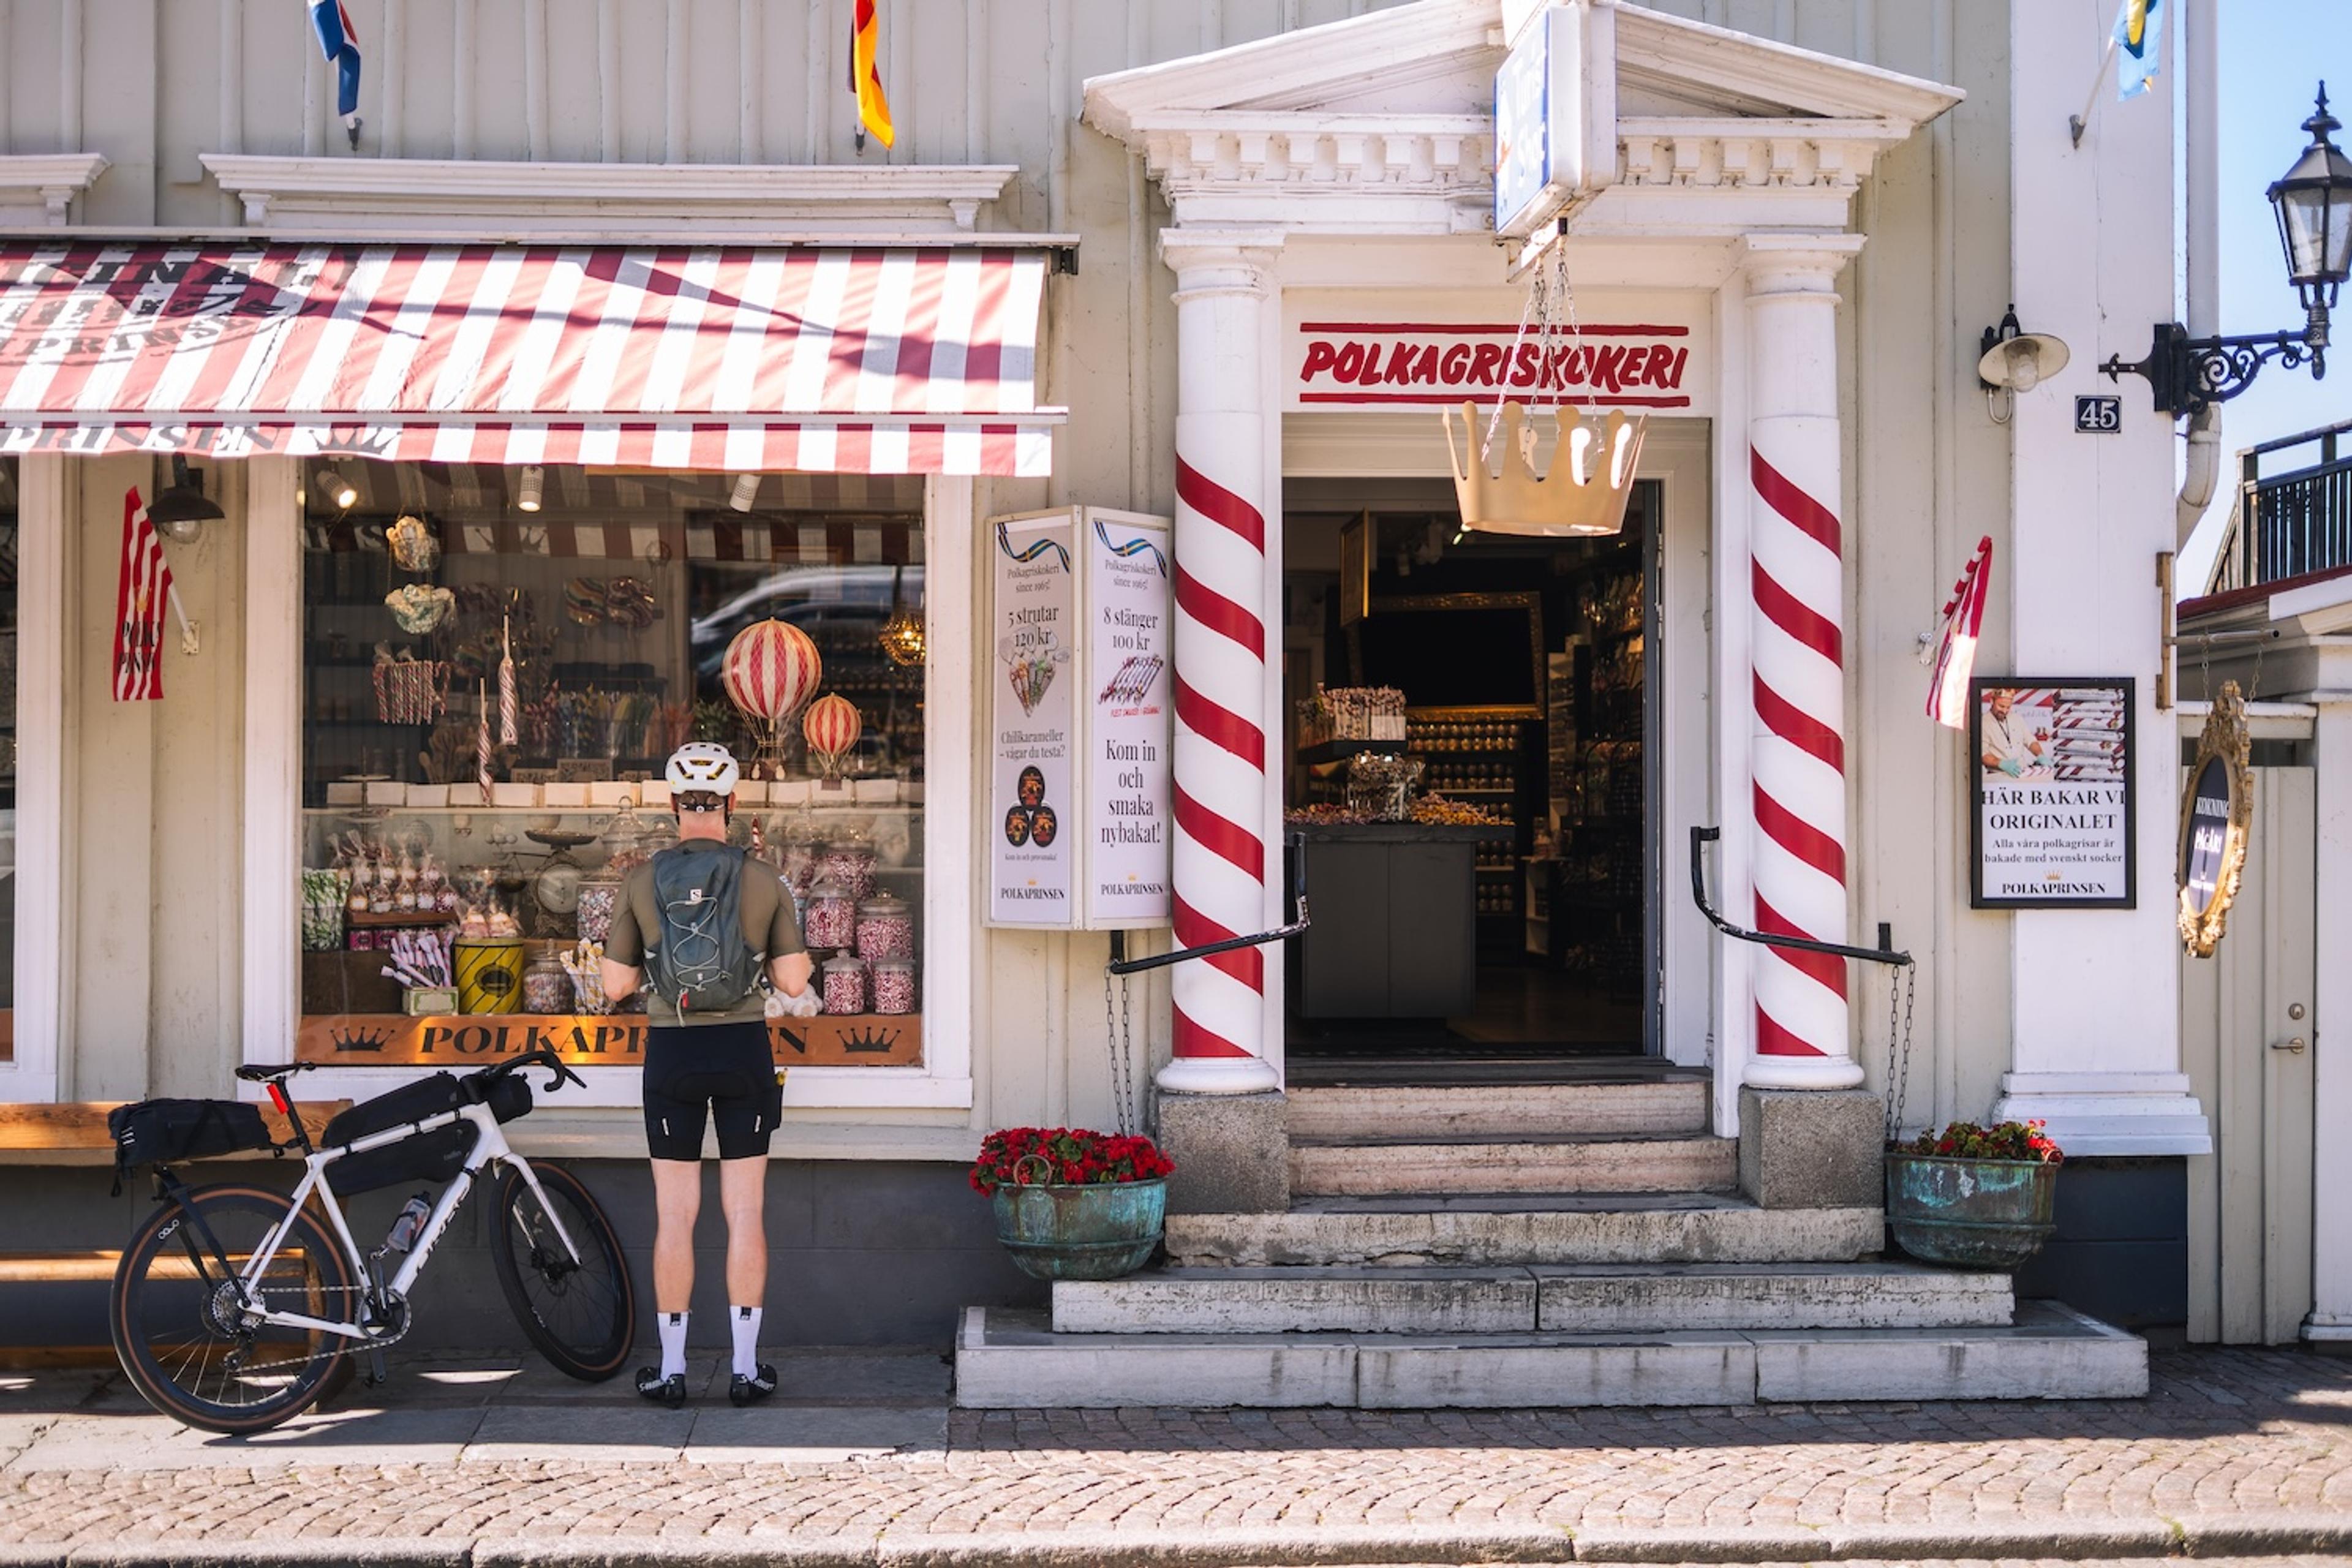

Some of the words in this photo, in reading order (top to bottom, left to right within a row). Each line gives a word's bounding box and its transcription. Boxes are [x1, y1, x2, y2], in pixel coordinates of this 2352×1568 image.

[1300, 341, 1689, 394] POLKAGRISKOKERI
[2080, 401, 2117, 428] 45
[1105, 560, 1156, 577] Polkagriskokeri
[1016, 582, 1033, 593] since
[1113, 575, 1131, 587] since
[1009, 612, 1014, 628] 5
[1016, 605, 1059, 624] strutar
[1104, 606, 1111, 625] 8
[1114, 608, 1158, 631] stänger
[1015, 632, 1035, 647] 120
[1038, 627, 1052, 645] kr
[1112, 635, 1134, 650] 100
[1136, 631, 1150, 650] kr
[1030, 745, 1039, 758] du
[1041, 744, 1065, 758] testa?
[1106, 739, 1139, 761] Kom
[1142, 739, 1156, 761] in
[1118, 766, 1144, 788] och
[1108, 793, 1154, 816] smaka
[1982, 786, 2025, 805] HÄR
[2030, 790, 2100, 805] BAKAR
[2105, 790, 2125, 804] VI
[1990, 814, 2117, 829] ORIGINALET
[1101, 821, 1161, 848] nybakat!
[1992, 839, 2014, 848] Alla
[2016, 837, 2039, 848] våra
[2043, 839, 2100, 851] polkagrisar
[2104, 839, 2115, 848] är
[1985, 854, 2022, 863] bakade
[2024, 853, 2047, 863] med
[2049, 853, 2087, 863] svenskt
[2090, 853, 2122, 863] socker
[1000, 888, 1065, 900] POLKAPRINSEN
[1101, 883, 1164, 896] POLKAPRINSEN
[2002, 883, 2106, 894] POLKAPRINSEN
